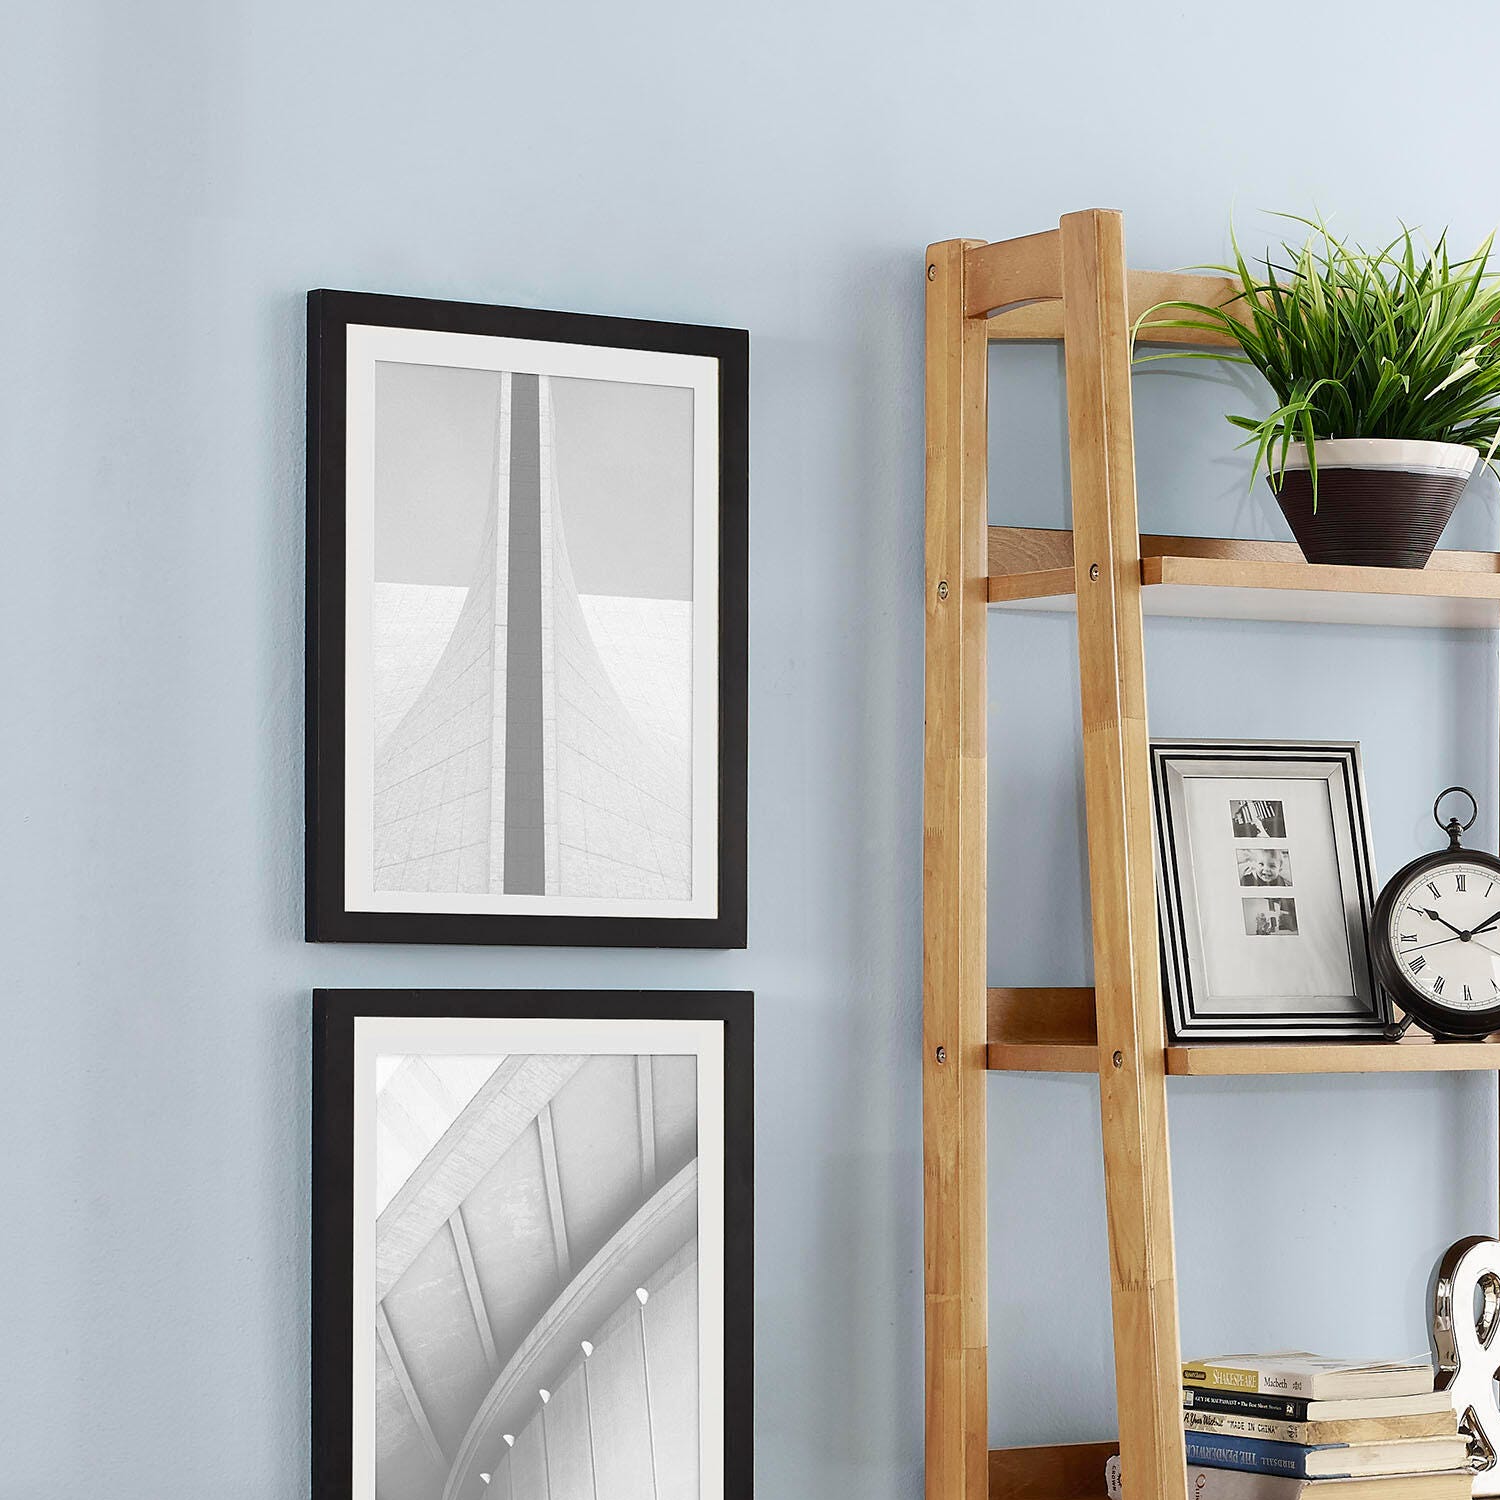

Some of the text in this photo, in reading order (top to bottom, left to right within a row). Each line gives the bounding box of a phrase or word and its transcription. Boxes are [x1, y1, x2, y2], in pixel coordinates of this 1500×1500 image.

[1426, 881, 1442, 900] XI
[1455, 874, 1467, 892] XII
[1406, 903, 1425, 917] X
[1400, 933, 1418, 942] IX
[1407, 955, 1426, 975] VIII
[1433, 975, 1446, 995] VII
[1463, 984, 1473, 1001] VI
[1212, 1368, 1257, 1388] SHAKESPEARE
[1263, 1376, 1288, 1390] Macbeth
[1248, 1422, 1255, 1432] IN
[1240, 1451, 1257, 1466] THE
[1260, 1456, 1296, 1470] BIRDSALL
